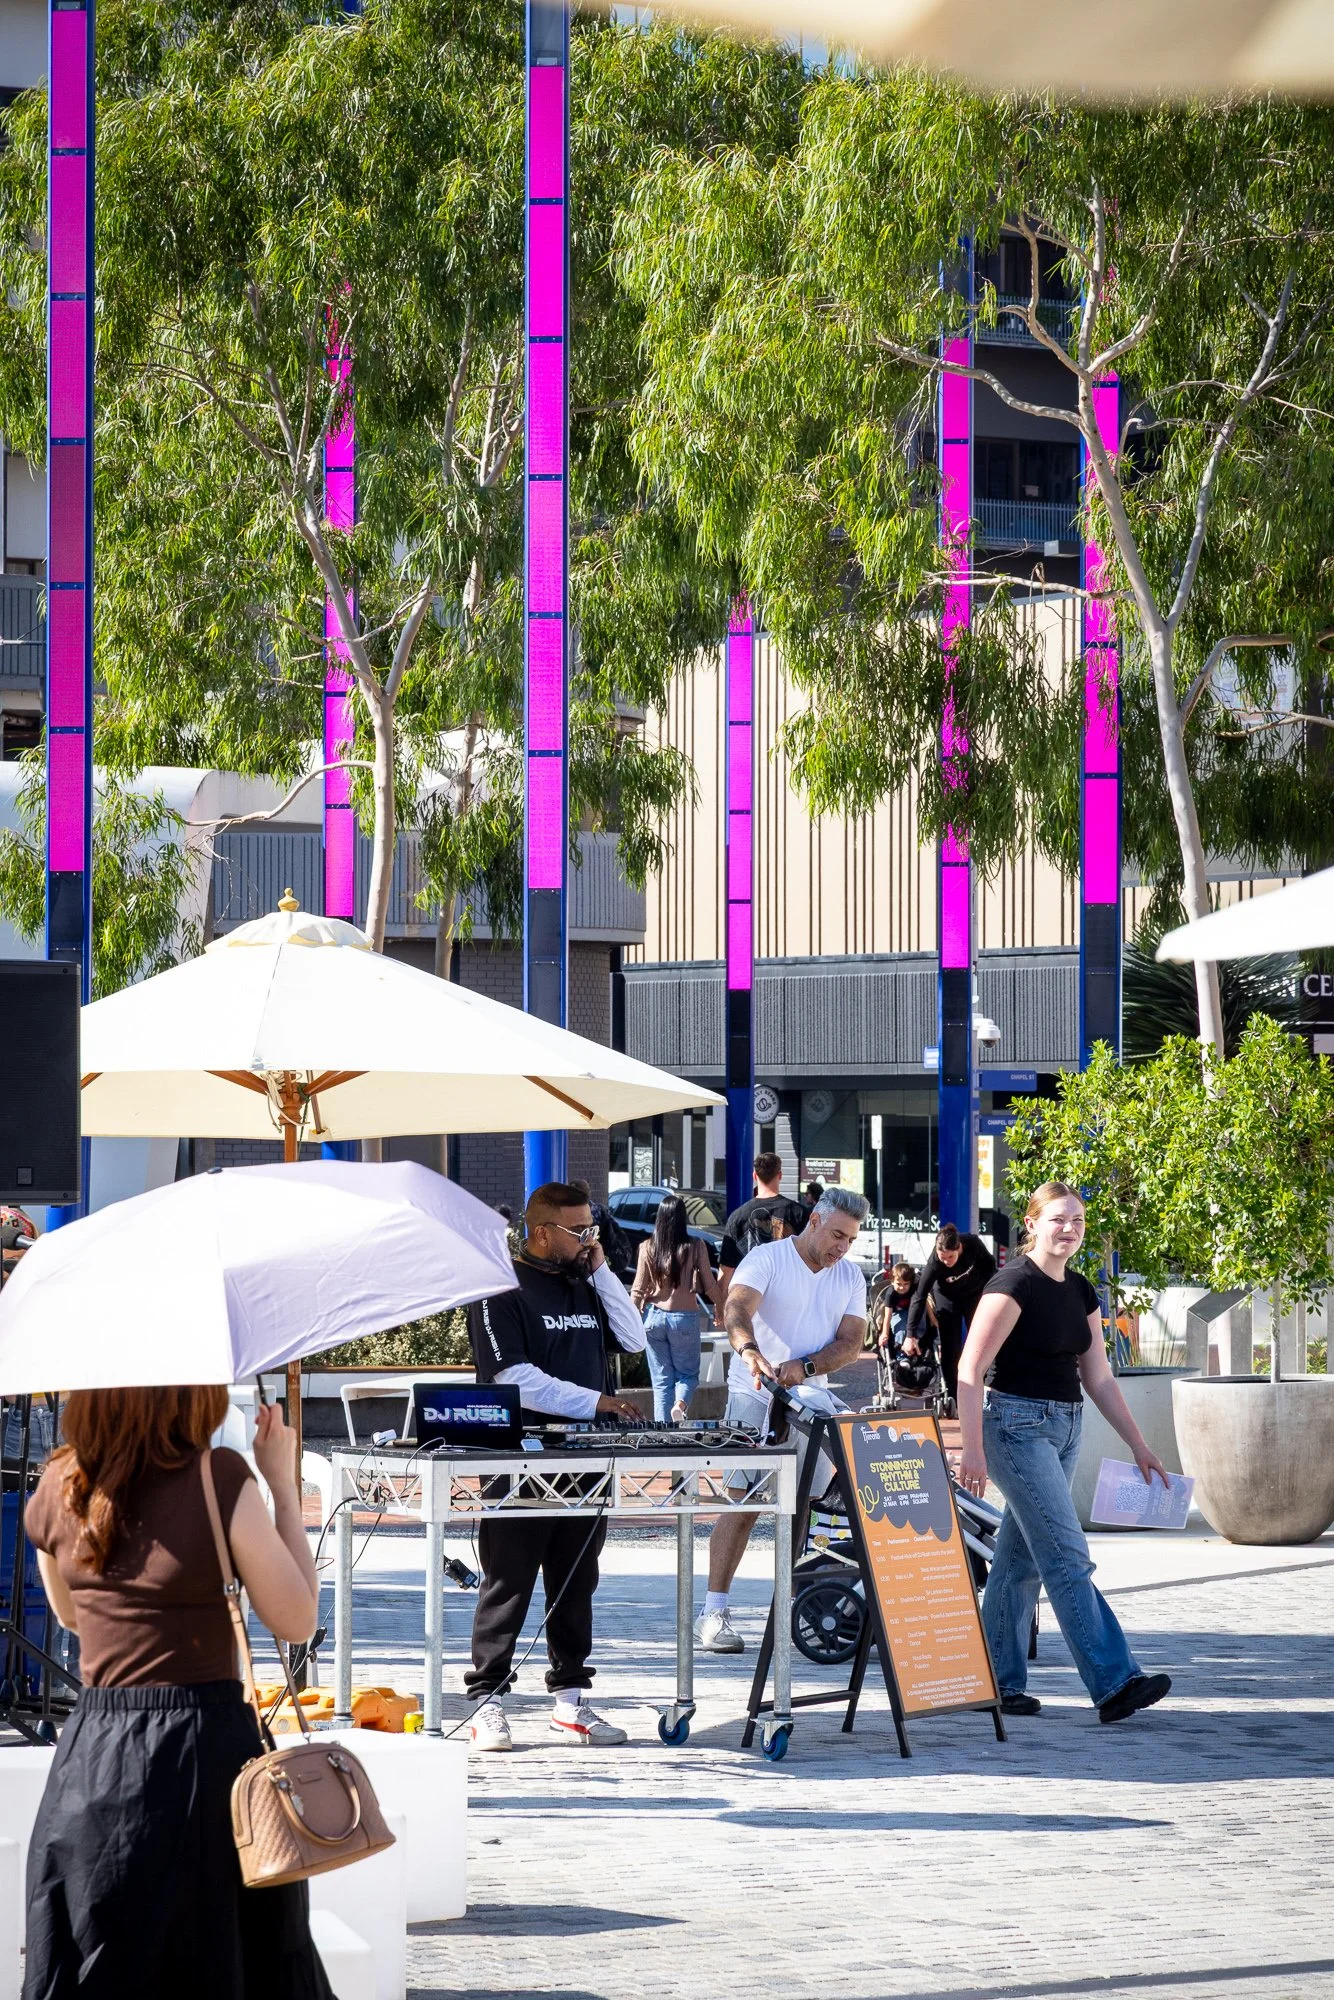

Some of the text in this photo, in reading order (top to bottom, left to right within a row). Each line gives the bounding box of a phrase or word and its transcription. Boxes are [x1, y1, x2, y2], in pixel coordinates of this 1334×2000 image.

[1303, 974, 1334, 997] CE
[898, 1213, 923, 1231] Pasta
[541, 1314, 599, 1331] DJ RUSH
[495, 1351, 502, 1361] DJ
[423, 1407, 510, 1422] DJ RUSH
[870, 1459, 924, 1473] STONNINGTON
[880, 1469, 920, 1482] RHYTHM &
[884, 1480, 921, 1492] CULTURE
